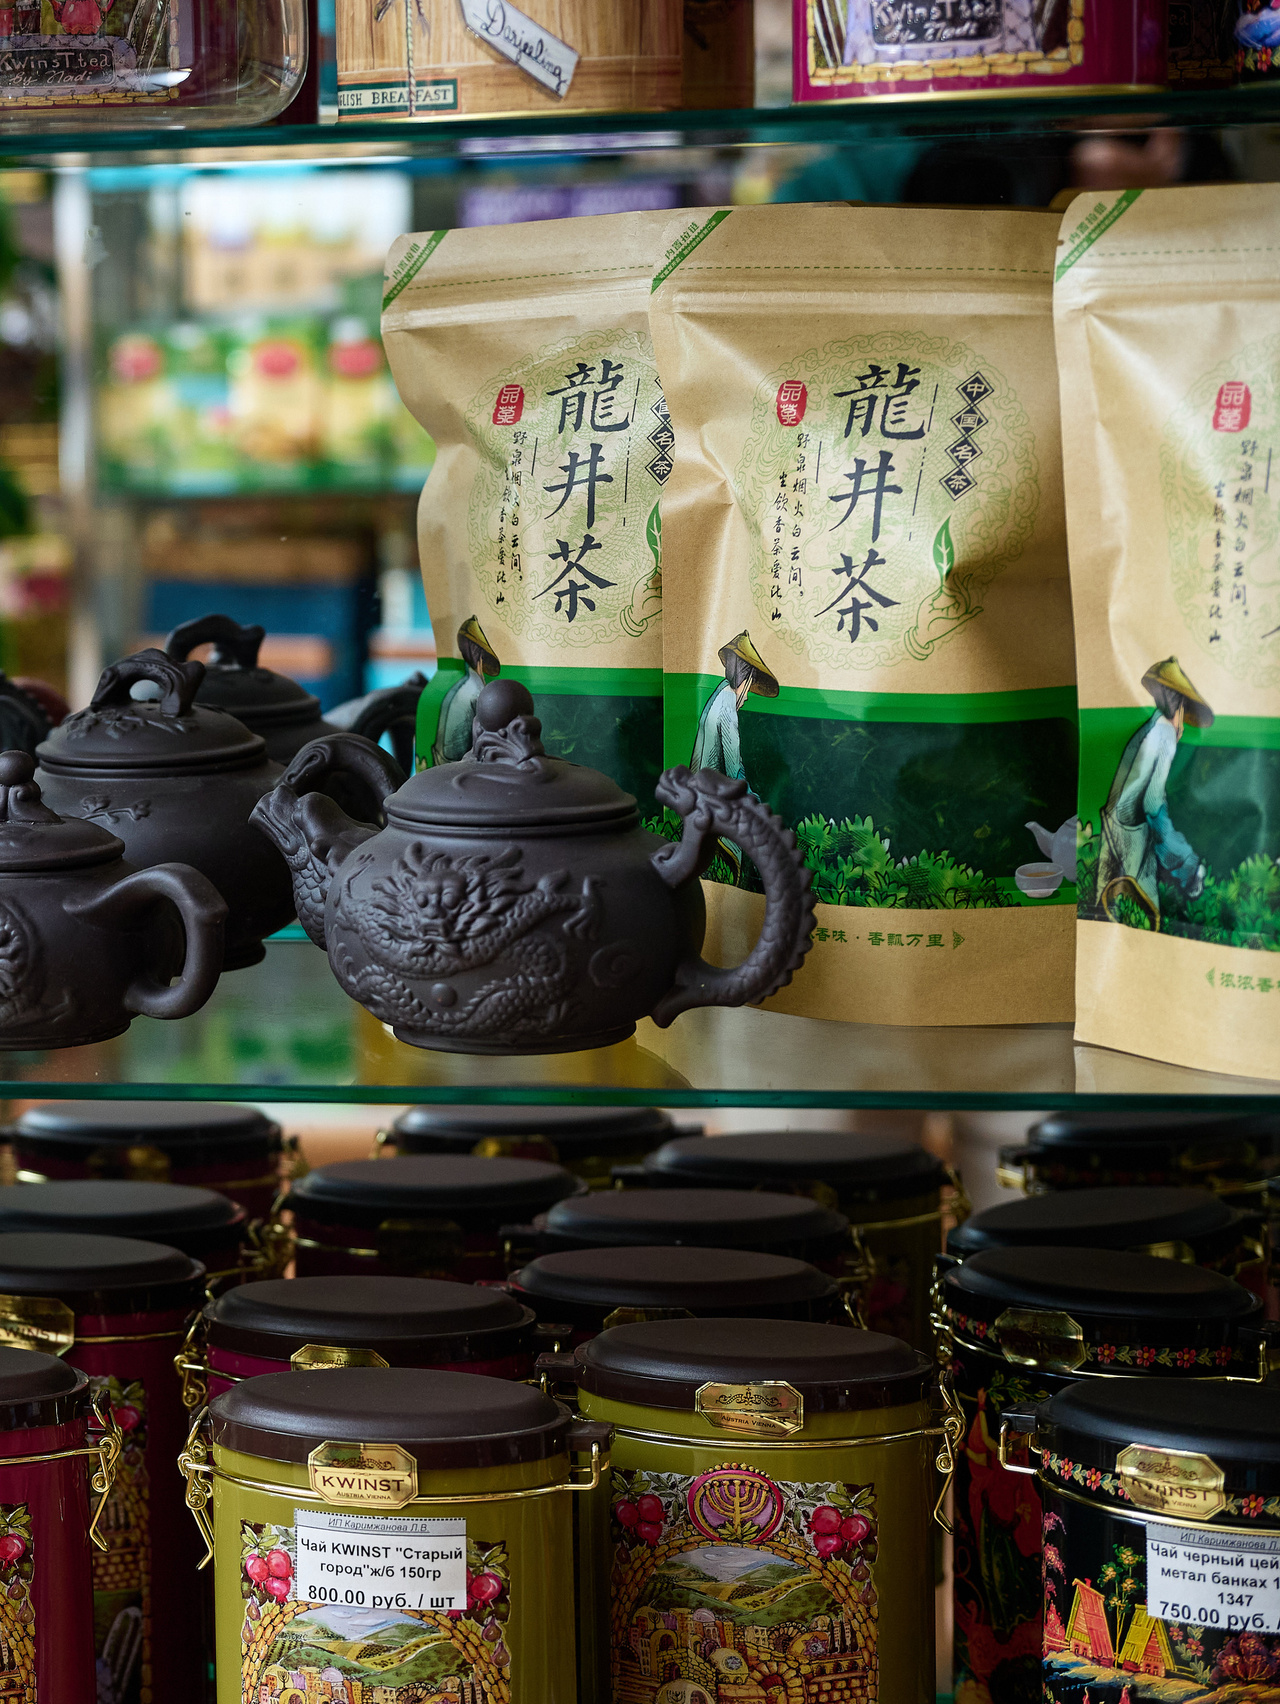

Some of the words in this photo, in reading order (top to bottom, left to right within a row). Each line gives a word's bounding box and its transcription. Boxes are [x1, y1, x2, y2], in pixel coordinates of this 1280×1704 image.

[77, 53, 112, 68] tea
[372, 88, 451, 105] BREAFAST
[946, 379, 987, 493] 中国名茶
[531, 359, 631, 623] 龍井茶
[814, 362, 926, 643] 龍井茶
[322, 1475, 405, 1492] KWINST
[328, 1517, 343, 1527] ИП
[344, 1519, 408, 1532] Каримжанова
[410, 1523, 430, 1533] Л.В.
[301, 1538, 327, 1553] Чай
[332, 1543, 391, 1559] KWINST
[395, 1546, 463, 1562] "Старый
[1180, 1532, 1195, 1543] ИП
[1198, 1534, 1266, 1549] Каримжанова
[1150, 1542, 1178, 1559] Чай
[1183, 1551, 1244, 1567] черный
[1249, 1556, 1280, 1570] цей
[399, 1566, 442, 1581] 150гр
[1161, 1567, 1207, 1583] метал
[1211, 1571, 1268, 1589] банках
[308, 1585, 365, 1605] 800.00
[372, 1593, 412, 1609] руб.
[418, 1593, 423, 1608] /
[430, 1596, 455, 1608] шт
[1217, 1592, 1254, 1607] 1347
[1160, 1601, 1220, 1624] 750.00
[1227, 1613, 1270, 1630] руб.
